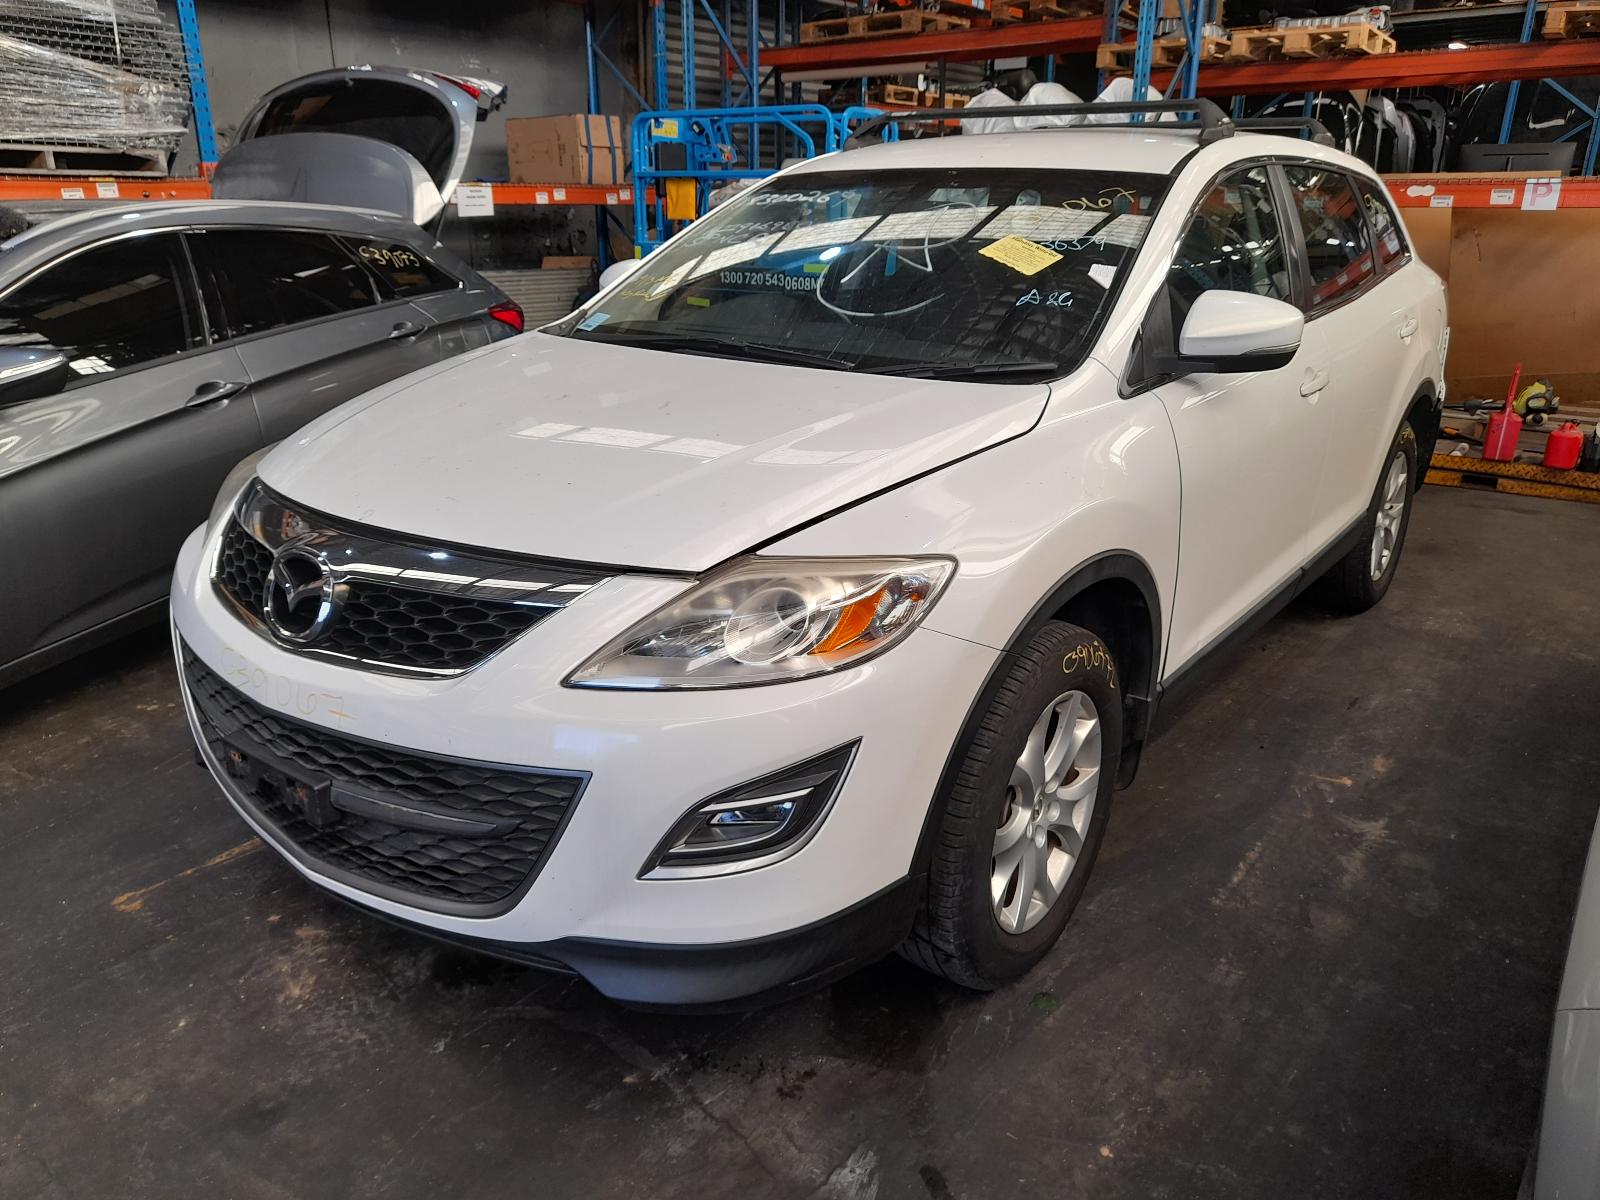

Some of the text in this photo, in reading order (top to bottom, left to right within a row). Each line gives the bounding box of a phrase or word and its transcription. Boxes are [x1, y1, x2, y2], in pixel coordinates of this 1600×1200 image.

[1529, 183, 1553, 207] P
[719, 271, 784, 287] 1300 720 543
